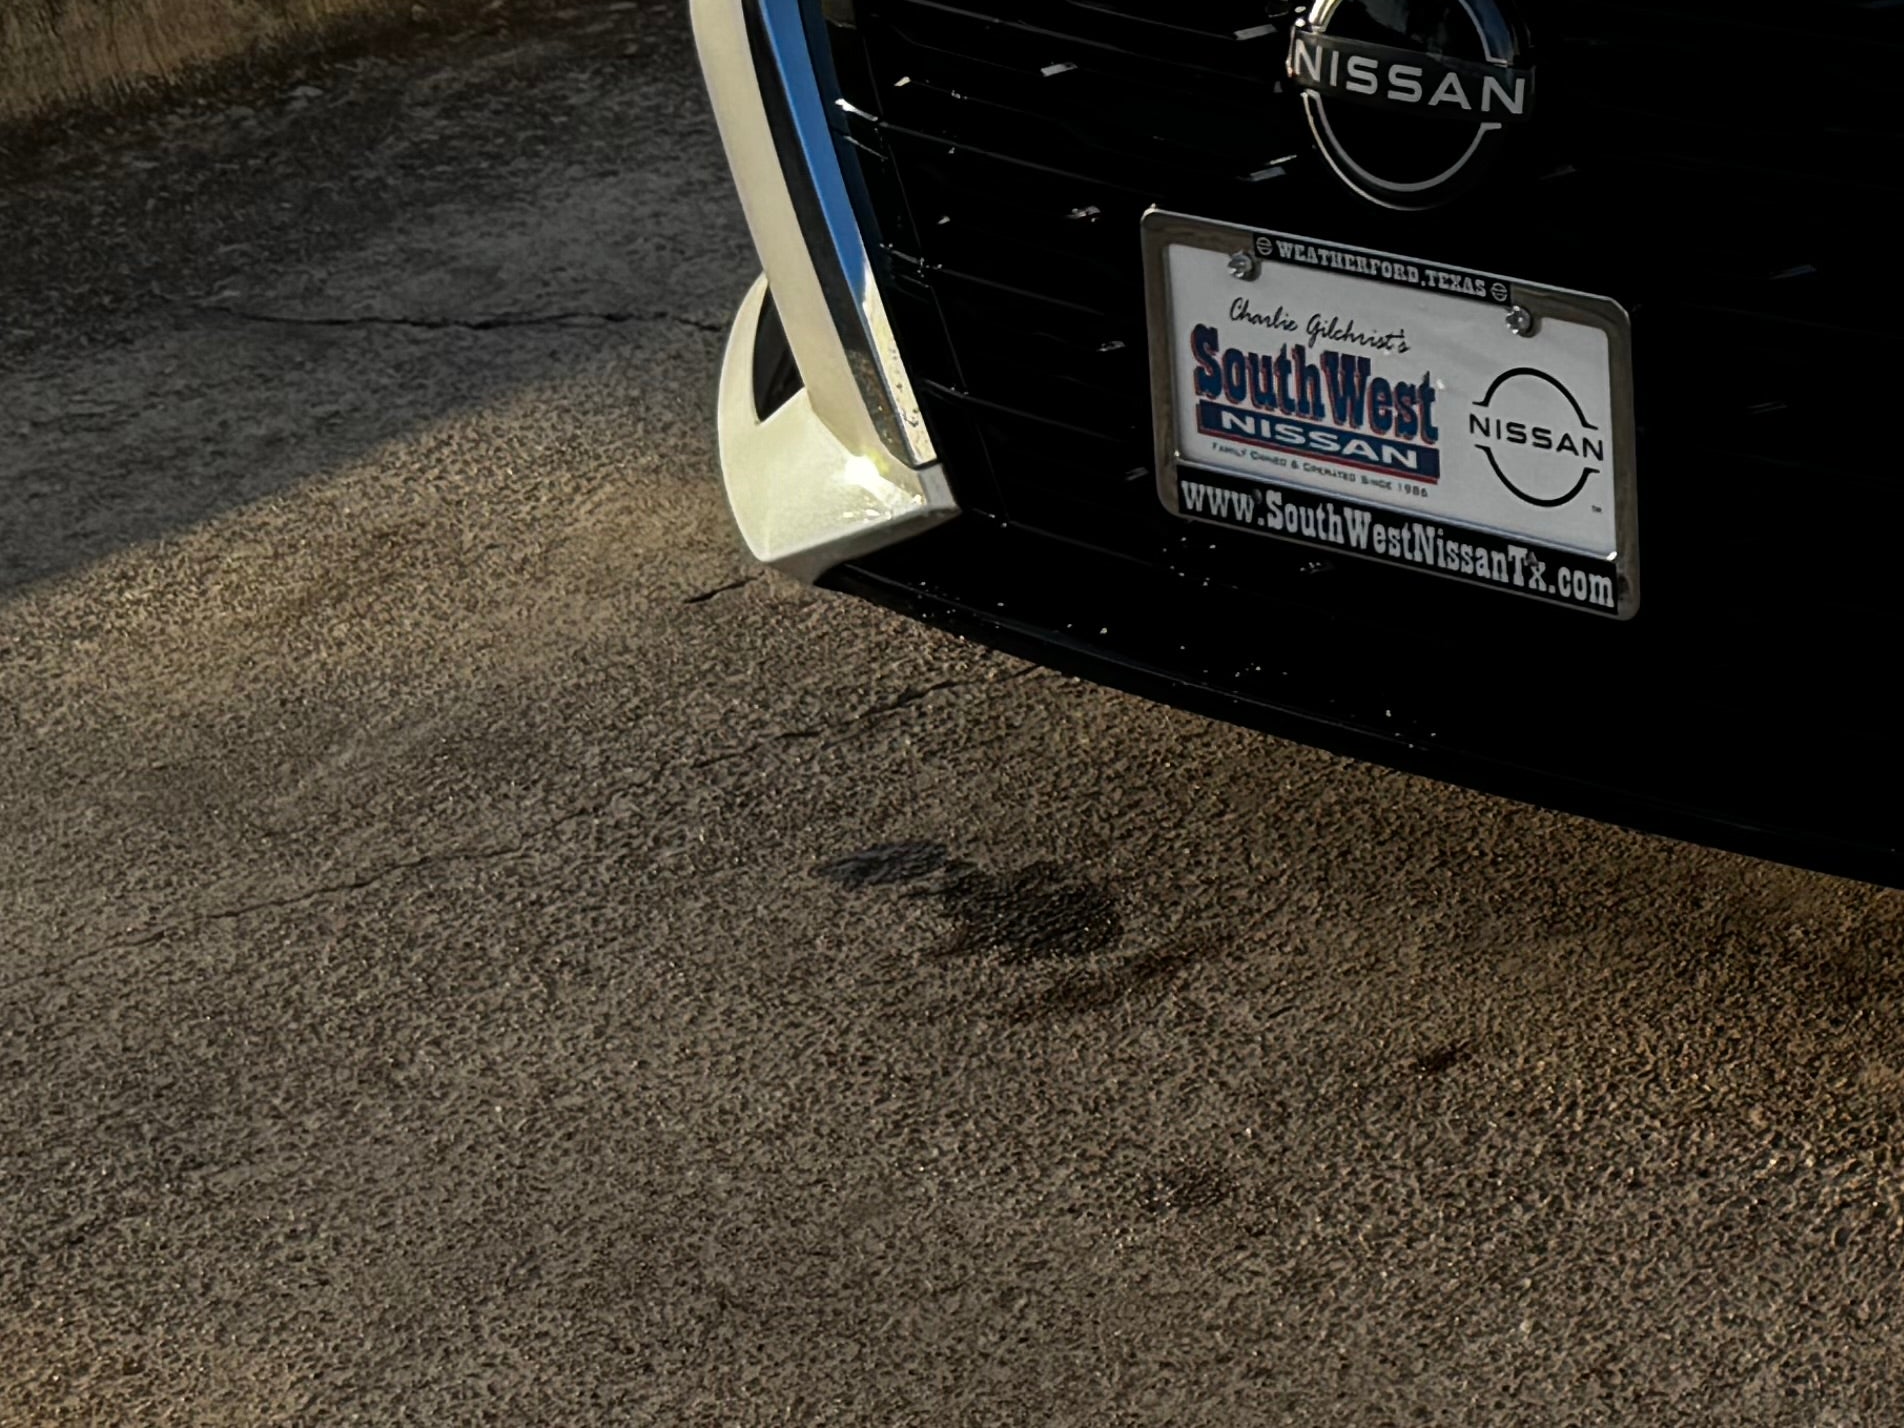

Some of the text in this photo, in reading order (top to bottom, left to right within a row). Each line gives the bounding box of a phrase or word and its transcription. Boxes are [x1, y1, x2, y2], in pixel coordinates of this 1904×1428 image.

[1294, 38, 1526, 115] NISSAN
[1229, 296, 1412, 354] Charlie Gilchrist's
[1191, 322, 1439, 445] SouthWest
[1220, 410, 1418, 470] NISSAN
[1469, 413, 1604, 462] NISSAN
[1181, 480, 1616, 608] www.SouthWestNissanTx.com
